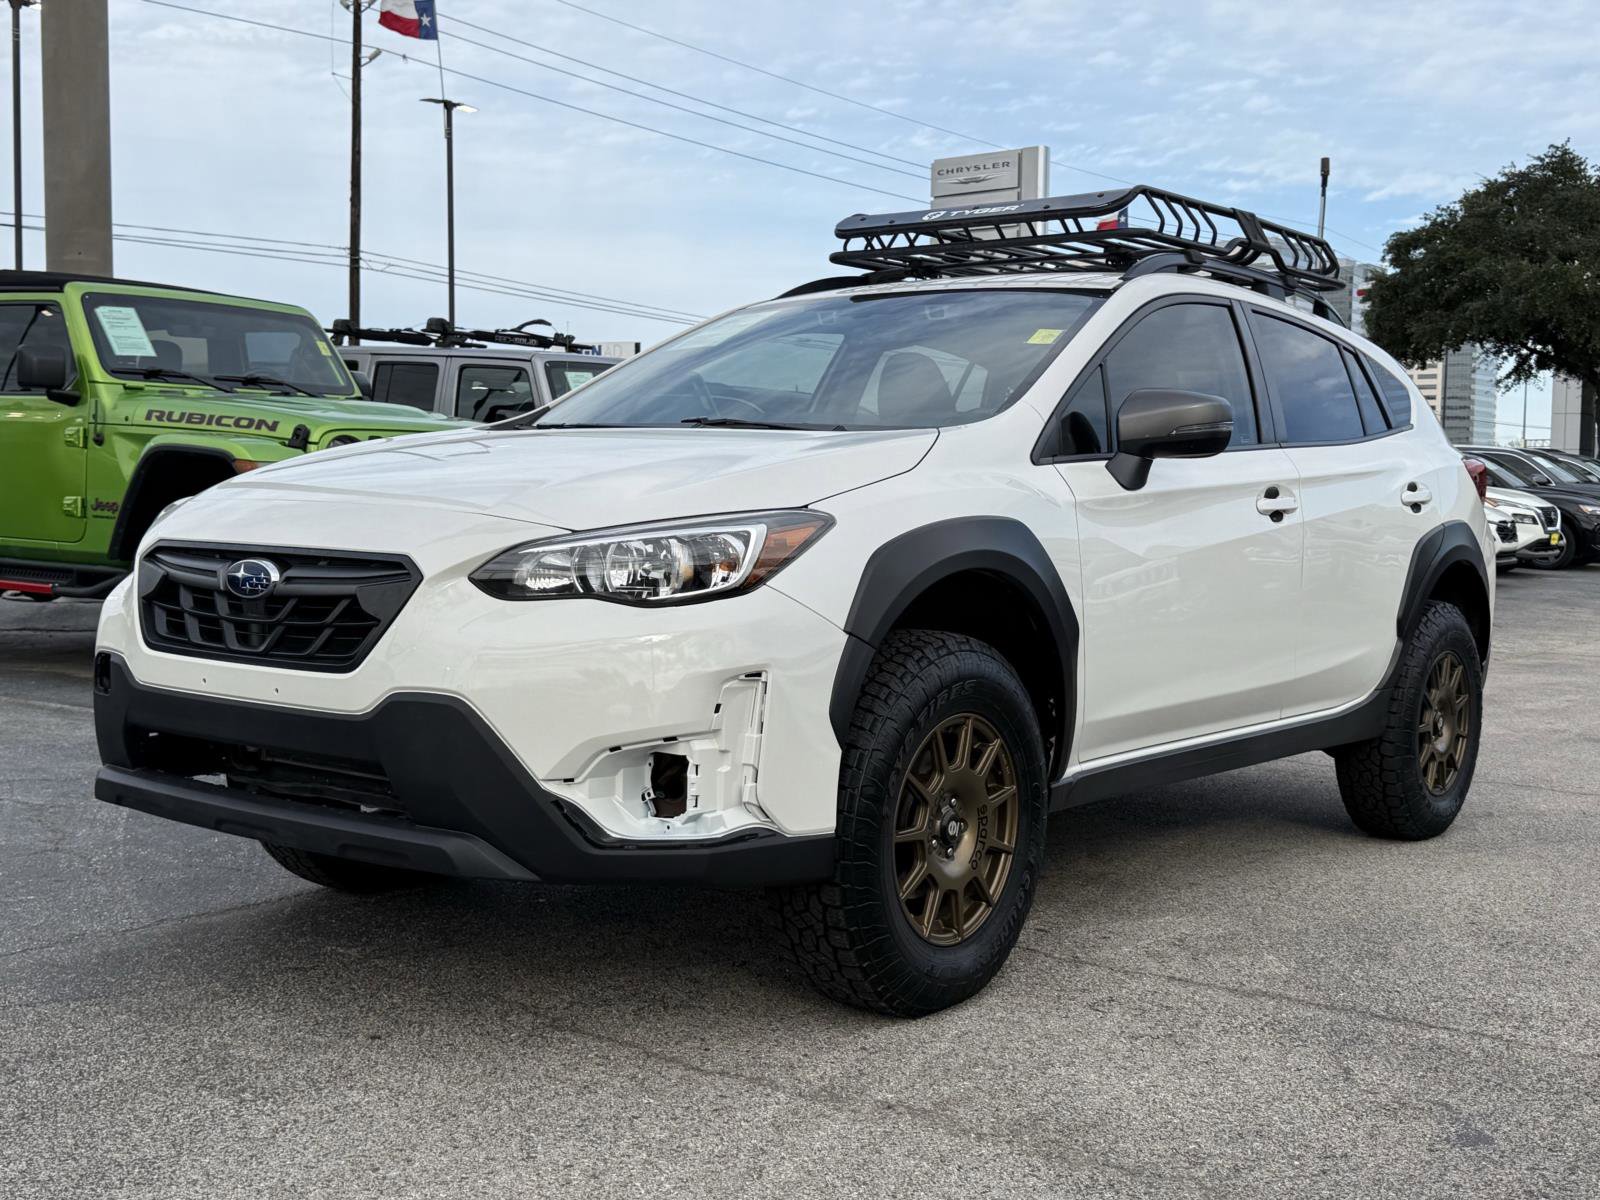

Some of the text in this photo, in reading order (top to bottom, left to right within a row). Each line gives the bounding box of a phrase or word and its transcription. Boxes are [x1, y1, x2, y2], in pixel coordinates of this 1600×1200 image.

[937, 161, 1010, 176] CHRYSLER
[950, 204, 1020, 217] TYGER
[144, 408, 280, 432] RUBICON
[91, 498, 118, 514] Jeep
[970, 804, 988, 870] sparco
